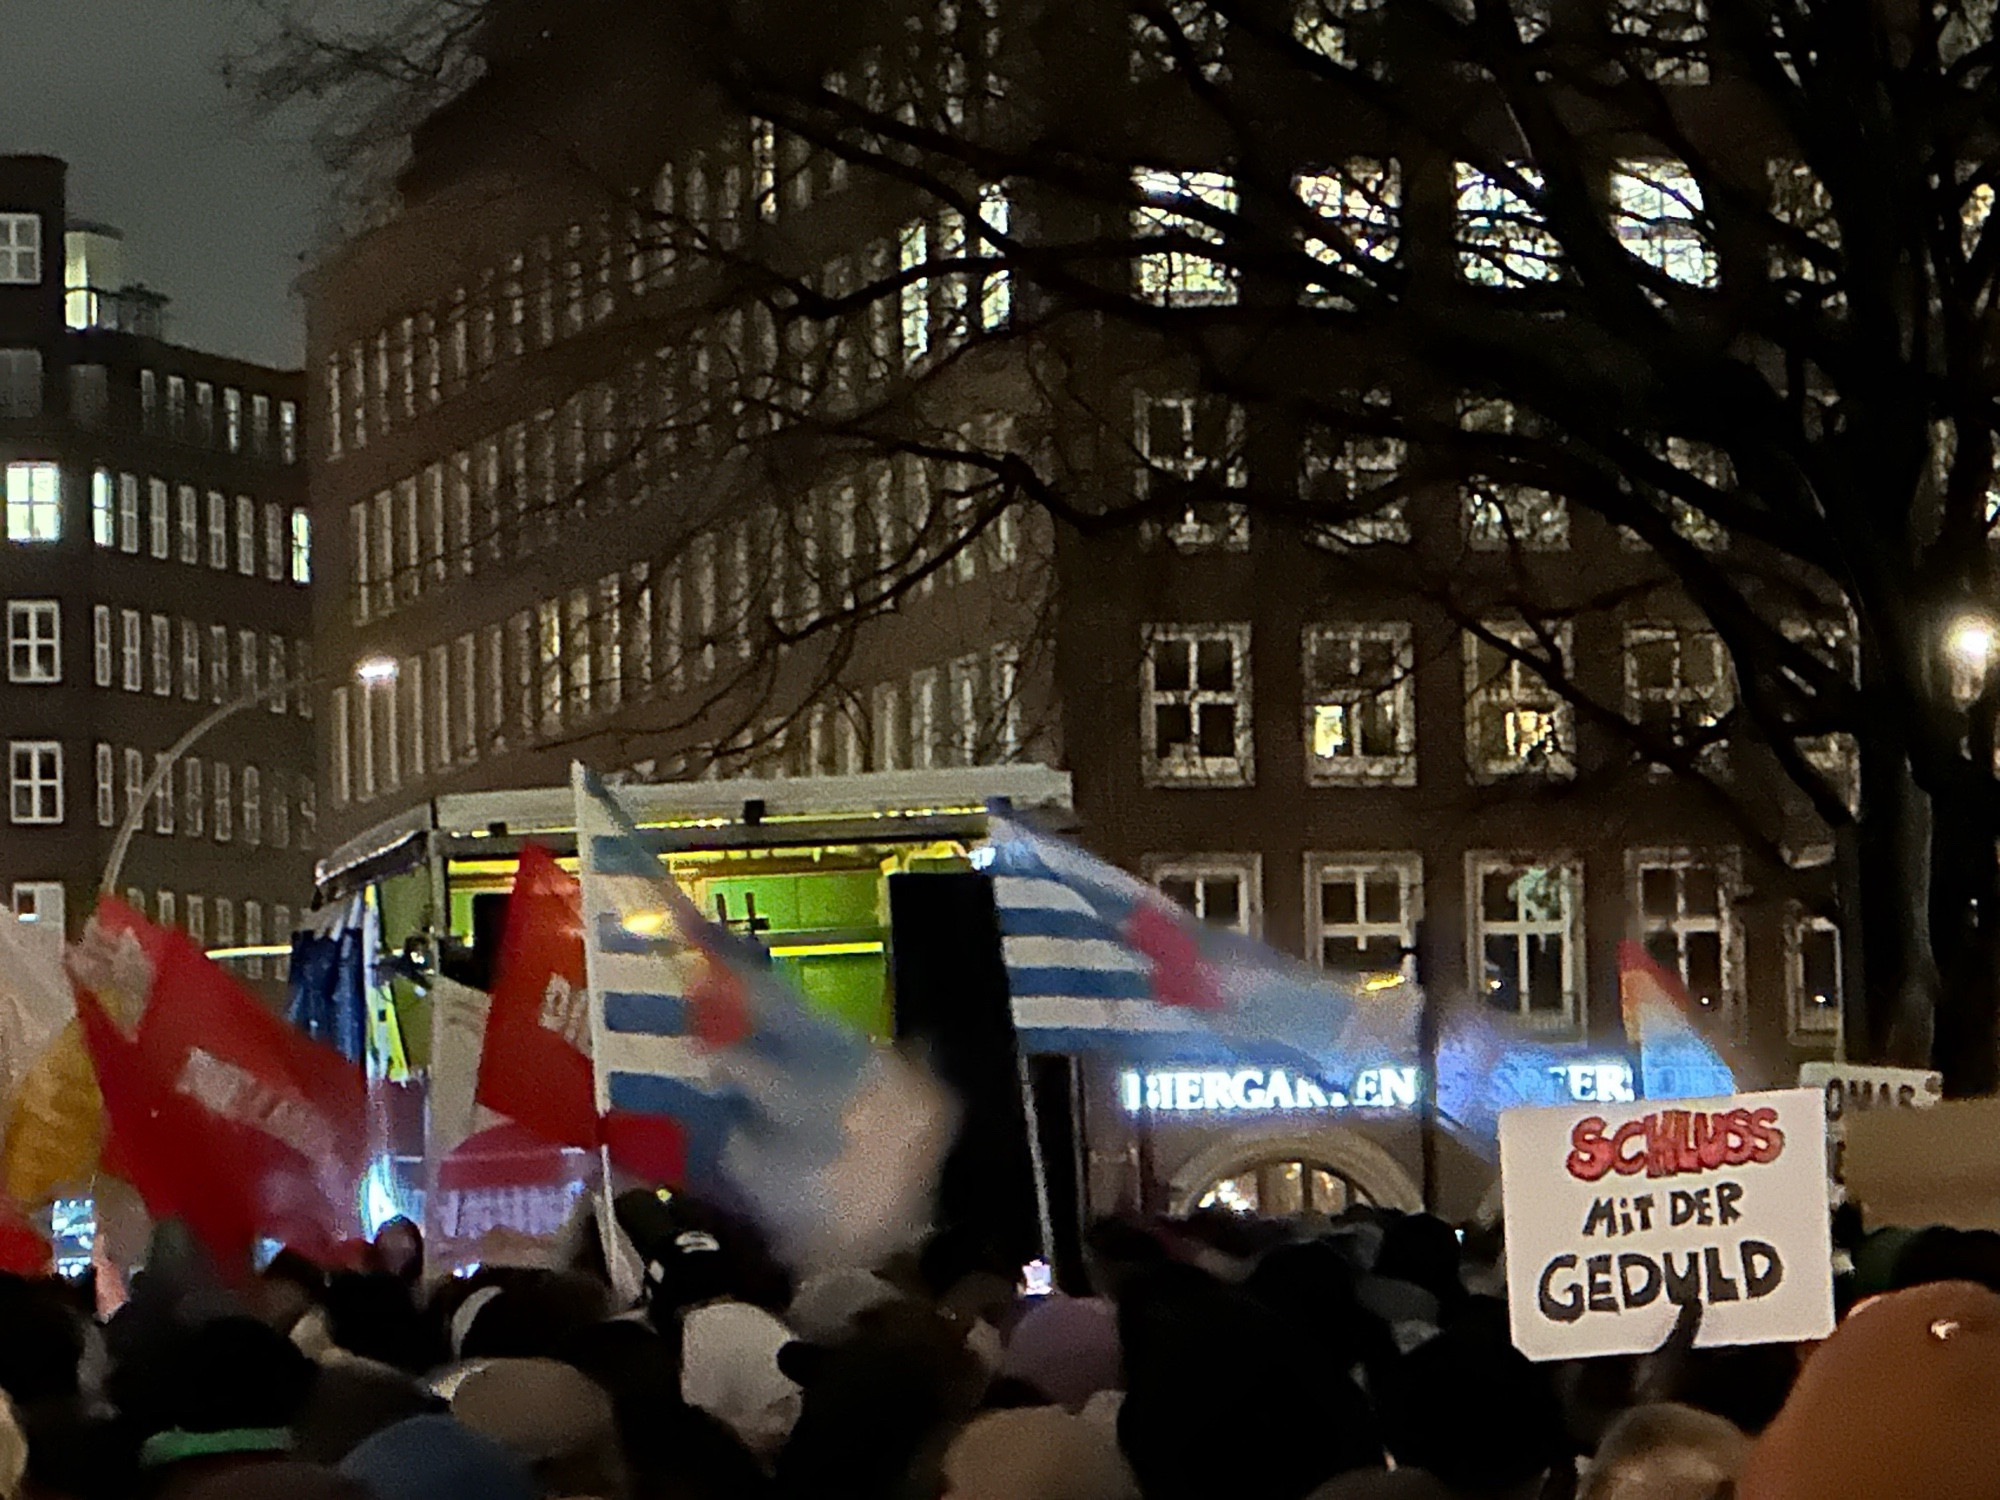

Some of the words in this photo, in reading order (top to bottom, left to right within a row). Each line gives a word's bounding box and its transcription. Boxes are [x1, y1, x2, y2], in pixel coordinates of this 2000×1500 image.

[1123, 1067, 1418, 1110] BIERGAREN
[1565, 1107, 1786, 1182] SCHLUSS
[1668, 1181, 1743, 1226] DER
[1537, 1239, 1785, 1324] GEDULD
